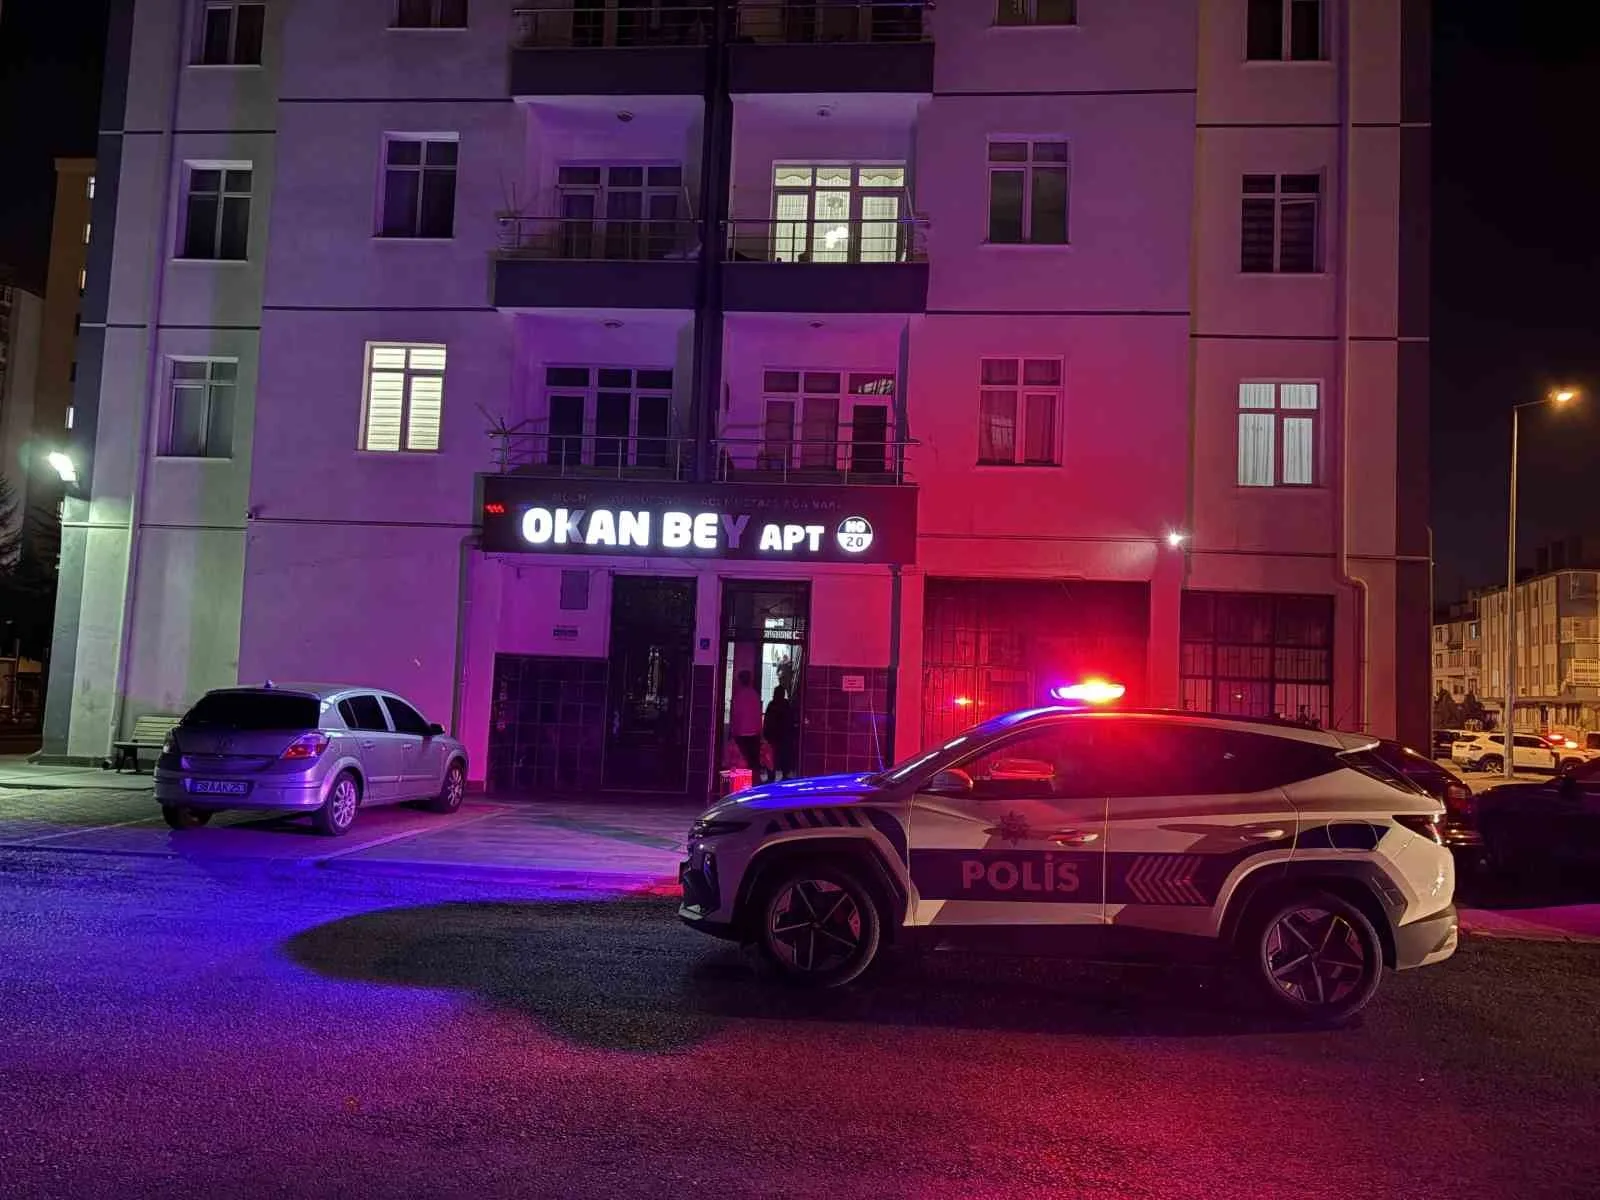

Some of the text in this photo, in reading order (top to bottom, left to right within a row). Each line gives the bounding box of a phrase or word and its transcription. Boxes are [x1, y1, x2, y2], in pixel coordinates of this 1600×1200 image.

[522, 507, 824, 551] OKAN BEY APT
[846, 536, 864, 548] 20
[962, 853, 1080, 891] POLİS
